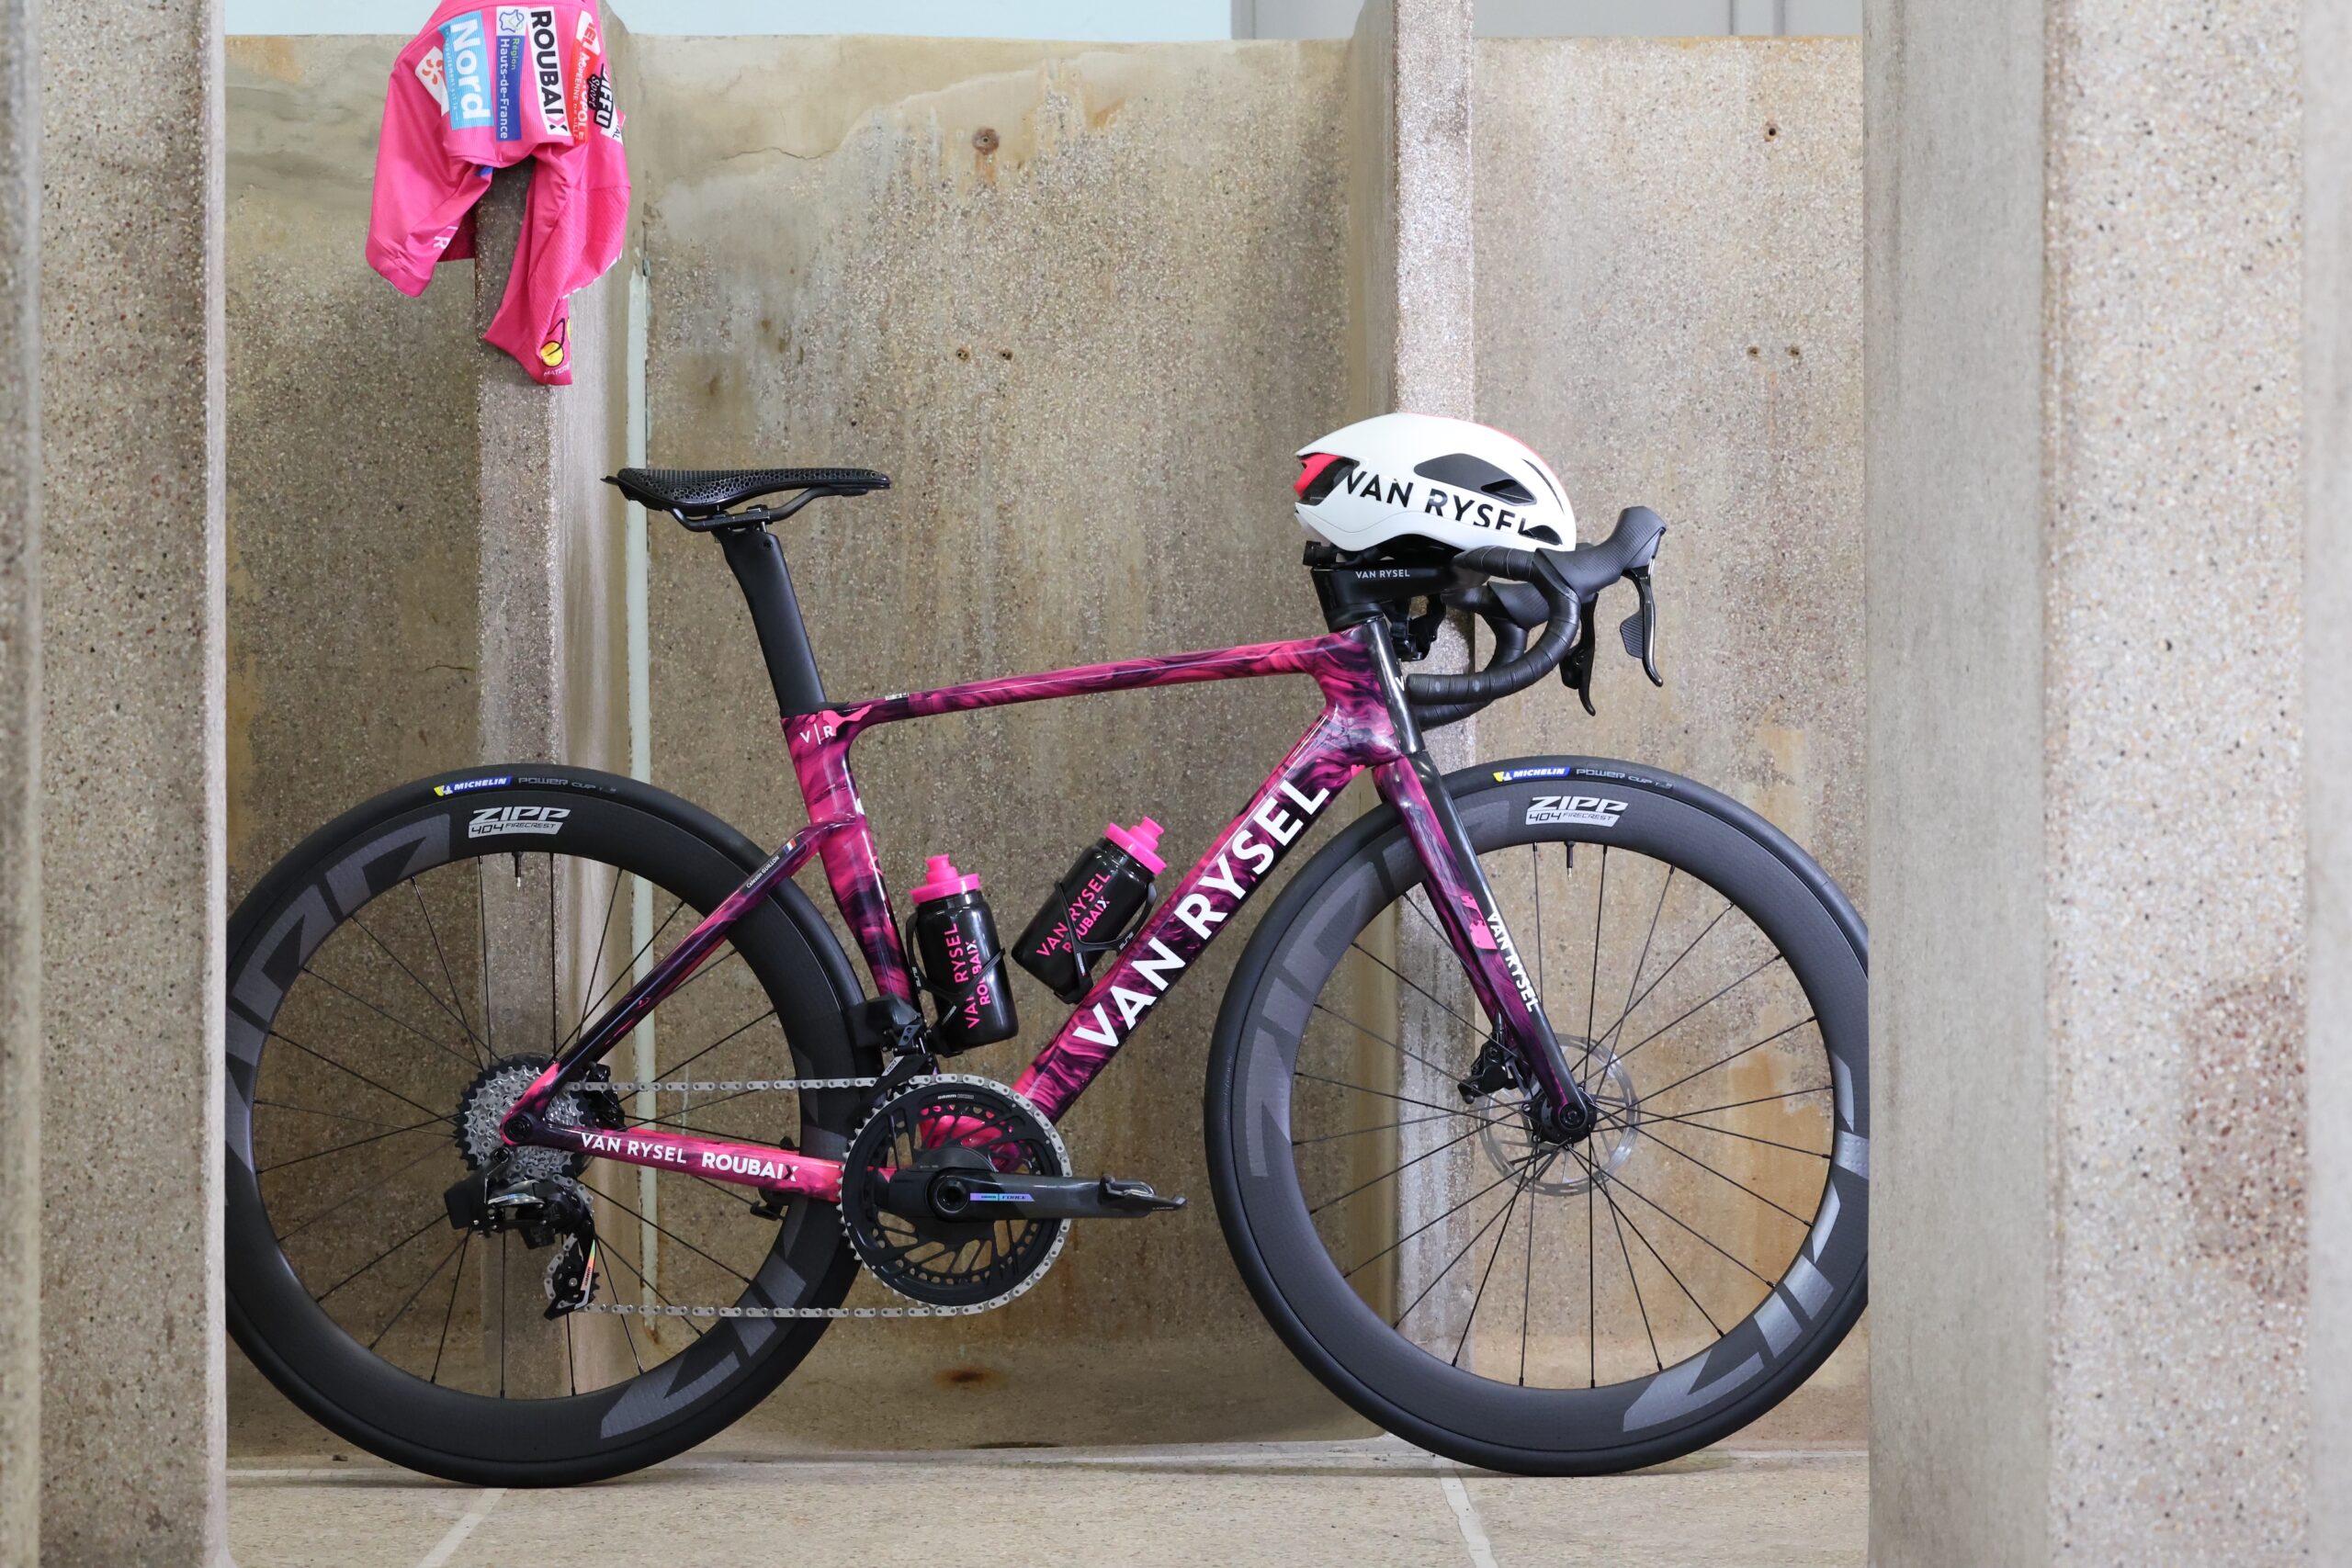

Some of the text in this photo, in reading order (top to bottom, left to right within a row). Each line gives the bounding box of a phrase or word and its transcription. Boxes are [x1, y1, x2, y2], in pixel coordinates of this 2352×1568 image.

[450, 18, 491, 118] Nord
[531, 11, 568, 131] ROUBAIX
[500, 39, 510, 139] Hauts-de-France
[588, 76, 600, 107] Sport
[1345, 470, 1414, 508] VAN
[1355, 569, 1410, 580] VAN RYSEL
[454, 777, 506, 791] MICHELIN
[517, 777, 568, 785] POWER
[1513, 767, 1566, 778] MICHELIN
[1576, 768, 1653, 784] POWER CUP
[469, 806, 571, 825] ZIPP
[1527, 795, 1629, 812] ZIPP
[1529, 812, 1562, 821] 404
[471, 824, 503, 834] 404
[1035, 873, 1111, 956] VAN RYSEL
[1062, 897, 1110, 953] RUBAIX
[1072, 779, 1330, 1047] VAN RYSEL
[944, 922, 969, 983] RYSEL
[1487, 910, 1539, 1012] VAN RYSEL
[964, 996, 980, 1029] VA
[581, 1133, 799, 1182] VAN RYSEL ROUBAIX
